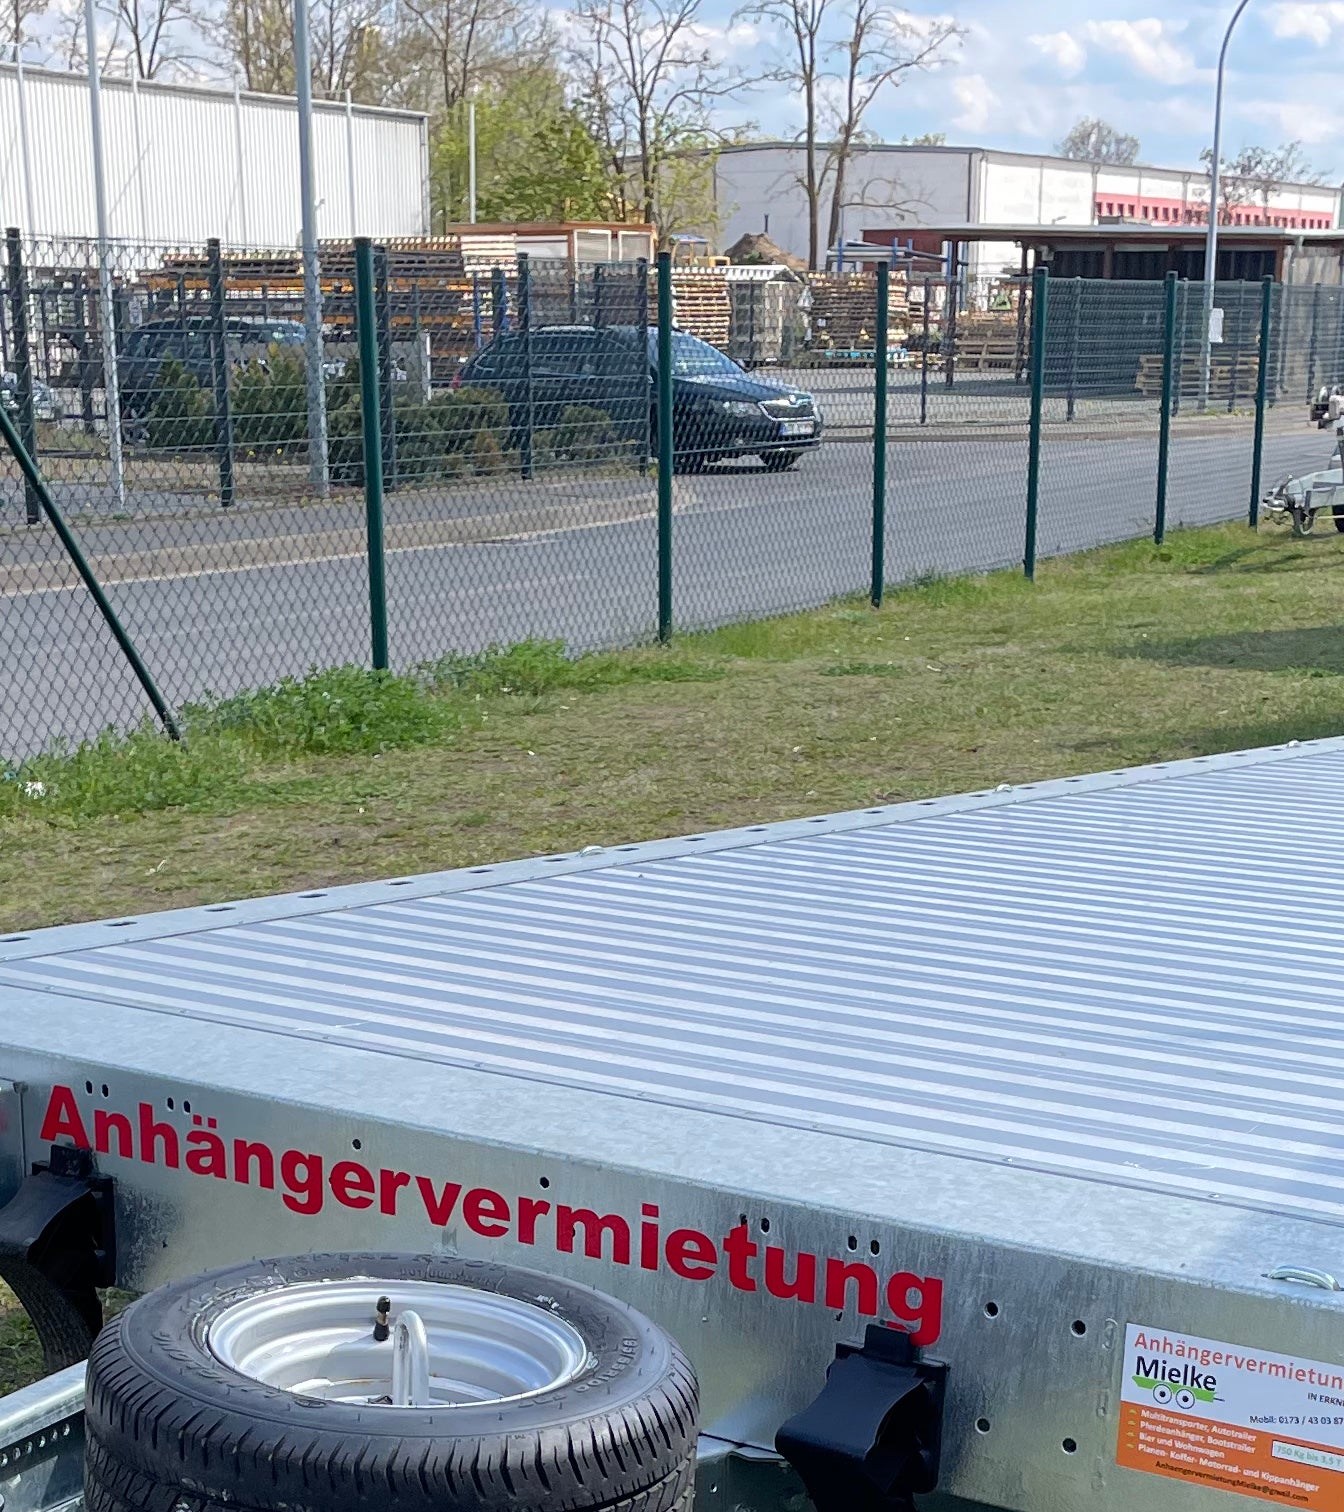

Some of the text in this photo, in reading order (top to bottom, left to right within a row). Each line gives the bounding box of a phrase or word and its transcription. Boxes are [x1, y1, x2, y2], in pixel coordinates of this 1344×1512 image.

[40, 1085, 943, 1347] Anhängervermietung
[1135, 1355, 1217, 1392] Mielke
[1307, 1392, 1317, 1401] IN
[1278, 1416, 1300, 1425] 0173
[1308, 1416, 1318, 1425] 43
[1320, 1416, 1331, 1425] 03
